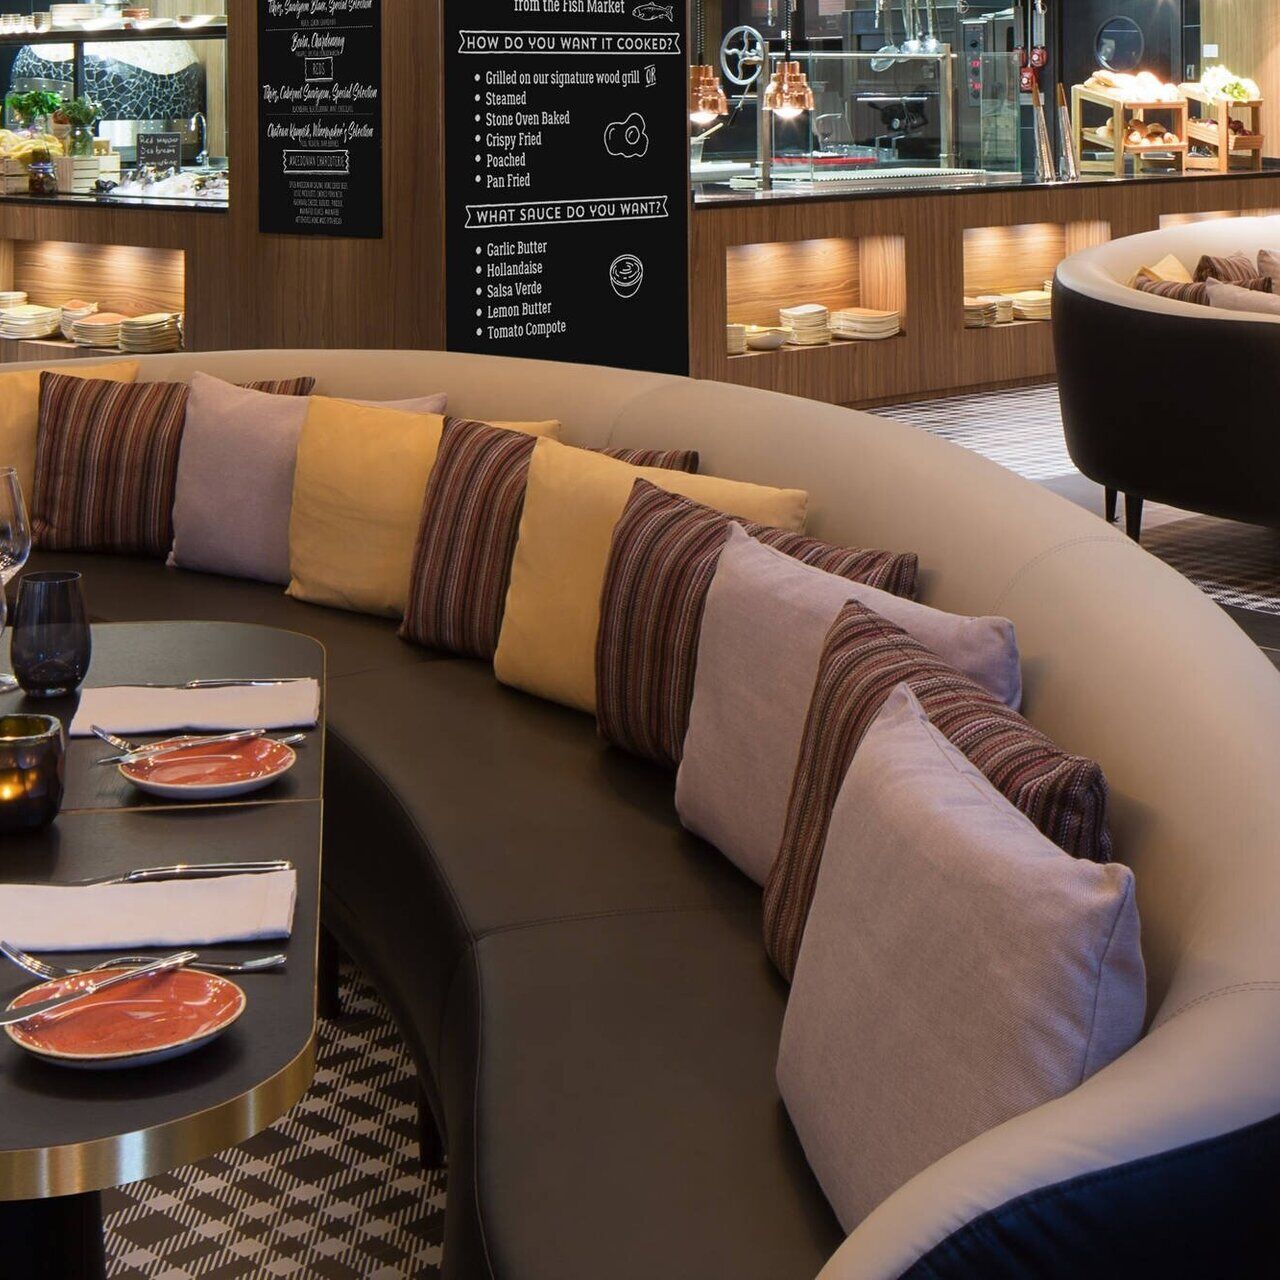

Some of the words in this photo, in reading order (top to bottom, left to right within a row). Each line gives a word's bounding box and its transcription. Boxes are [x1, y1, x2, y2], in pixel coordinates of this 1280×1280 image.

[468, 37, 498, 49] HOW
[505, 37, 523, 49] DO
[529, 37, 555, 49] YOU
[561, 37, 597, 49] WANT
[602, 38, 612, 49] IT
[617, 38, 672, 50] COOKED?
[312, 62, 325, 75] REDS
[486, 71, 516, 84] Grilled
[520, 74, 531, 84] on
[534, 74, 549, 84] our
[551, 72, 594, 88] signature
[596, 70, 620, 83] wood
[622, 70, 639, 87] grill
[486, 91, 526, 105] Steamed
[486, 113, 513, 126] Stone
[516, 112, 539, 125] Oven
[542, 111, 570, 124] Baked
[486, 133, 516, 150] Crispy
[519, 132, 541, 145] Fried
[487, 152, 525, 167] Poached
[487, 175, 505, 188] Pan
[507, 173, 530, 187] Fried
[477, 209, 515, 223] WHAT
[520, 207, 561, 220] SAUCE
[567, 206, 585, 218] DO
[590, 204, 615, 216] YOU
[620, 202, 660, 214] WANT?
[487, 242, 515, 256] Garlic
[518, 241, 547, 254] Butter
[488, 261, 542, 277] Hollandaise
[487, 284, 513, 298] Salsa
[515, 281, 541, 295] Verde
[488, 305, 519, 318] Lemon
[522, 302, 551, 315] Butter
[488, 325, 523, 339] Tomato
[526, 321, 566, 338] Compote
